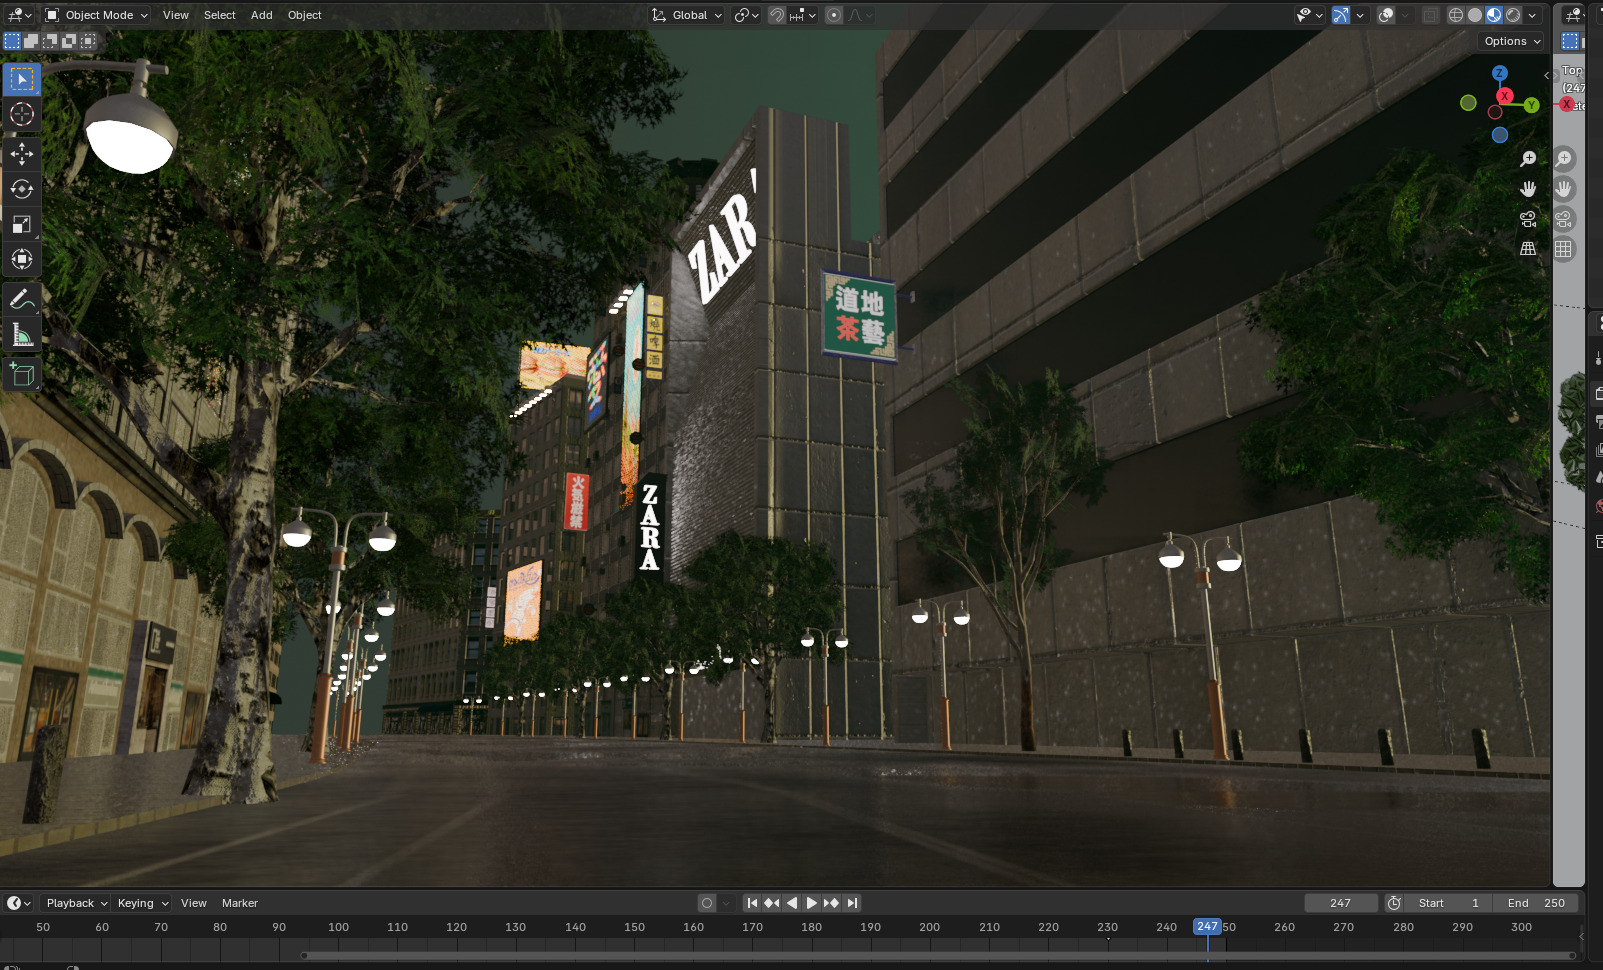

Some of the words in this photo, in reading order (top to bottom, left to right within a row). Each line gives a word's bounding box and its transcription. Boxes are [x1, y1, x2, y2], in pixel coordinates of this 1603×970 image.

[66, 10, 100, 22] Object
[103, 10, 134, 20] Mode
[162, 10, 190, 20] View
[204, 10, 236, 20] Select
[250, 10, 273, 20] Add
[288, 10, 322, 22] Object
[673, 10, 708, 20] Global
[1485, 36, 1527, 47] Options
[1496, 68, 1503, 78] Z
[1561, 65, 1583, 77] Top
[1501, 91, 1508, 101] X
[1528, 100, 1535, 110] Y
[1563, 99, 1571, 109] X
[688, 168, 756, 305] ZAR
[835, 284, 884, 317] 道地
[836, 315, 885, 346] 茶藝
[569, 475, 585, 529] 火気厳禁
[639, 484, 660, 571] ZARA
[47, 898, 95, 910] Playback
[118, 898, 154, 910] Keying
[181, 898, 208, 908] View
[222, 898, 259, 908] Marker
[1330, 898, 1351, 908] 247
[1418, 898, 1444, 908] Start
[1472, 898, 1479, 908] 1
[1508, 898, 1529, 908] End
[1544, 898, 1565, 908] 250
[36, 922, 50, 932] 50
[96, 922, 110, 932] 60
[155, 922, 169, 932] 70
[214, 922, 228, 932] 80
[273, 922, 287, 932] 90
[328, 922, 350, 932] 100
[388, 922, 409, 932] 110
[447, 922, 468, 932] 120
[506, 922, 527, 932] 130
[565, 922, 586, 932] 140
[624, 922, 645, 932] 150
[683, 922, 704, 932] 160
[742, 922, 763, 932] 170
[802, 922, 823, 932] 180
[861, 922, 882, 932] 190
[920, 922, 941, 932] 200
[979, 922, 1000, 932] 210
[1038, 922, 1059, 932] 220
[1097, 922, 1118, 932] 230
[1156, 922, 1177, 932] 240
[1197, 921, 1218, 931] 247
[1222, 922, 1237, 932] 50
[1274, 922, 1295, 932] 260
[1333, 922, 1354, 932] 270
[1393, 922, 1414, 932] 280
[1452, 922, 1473, 932] 290
[1511, 922, 1532, 932] 300
